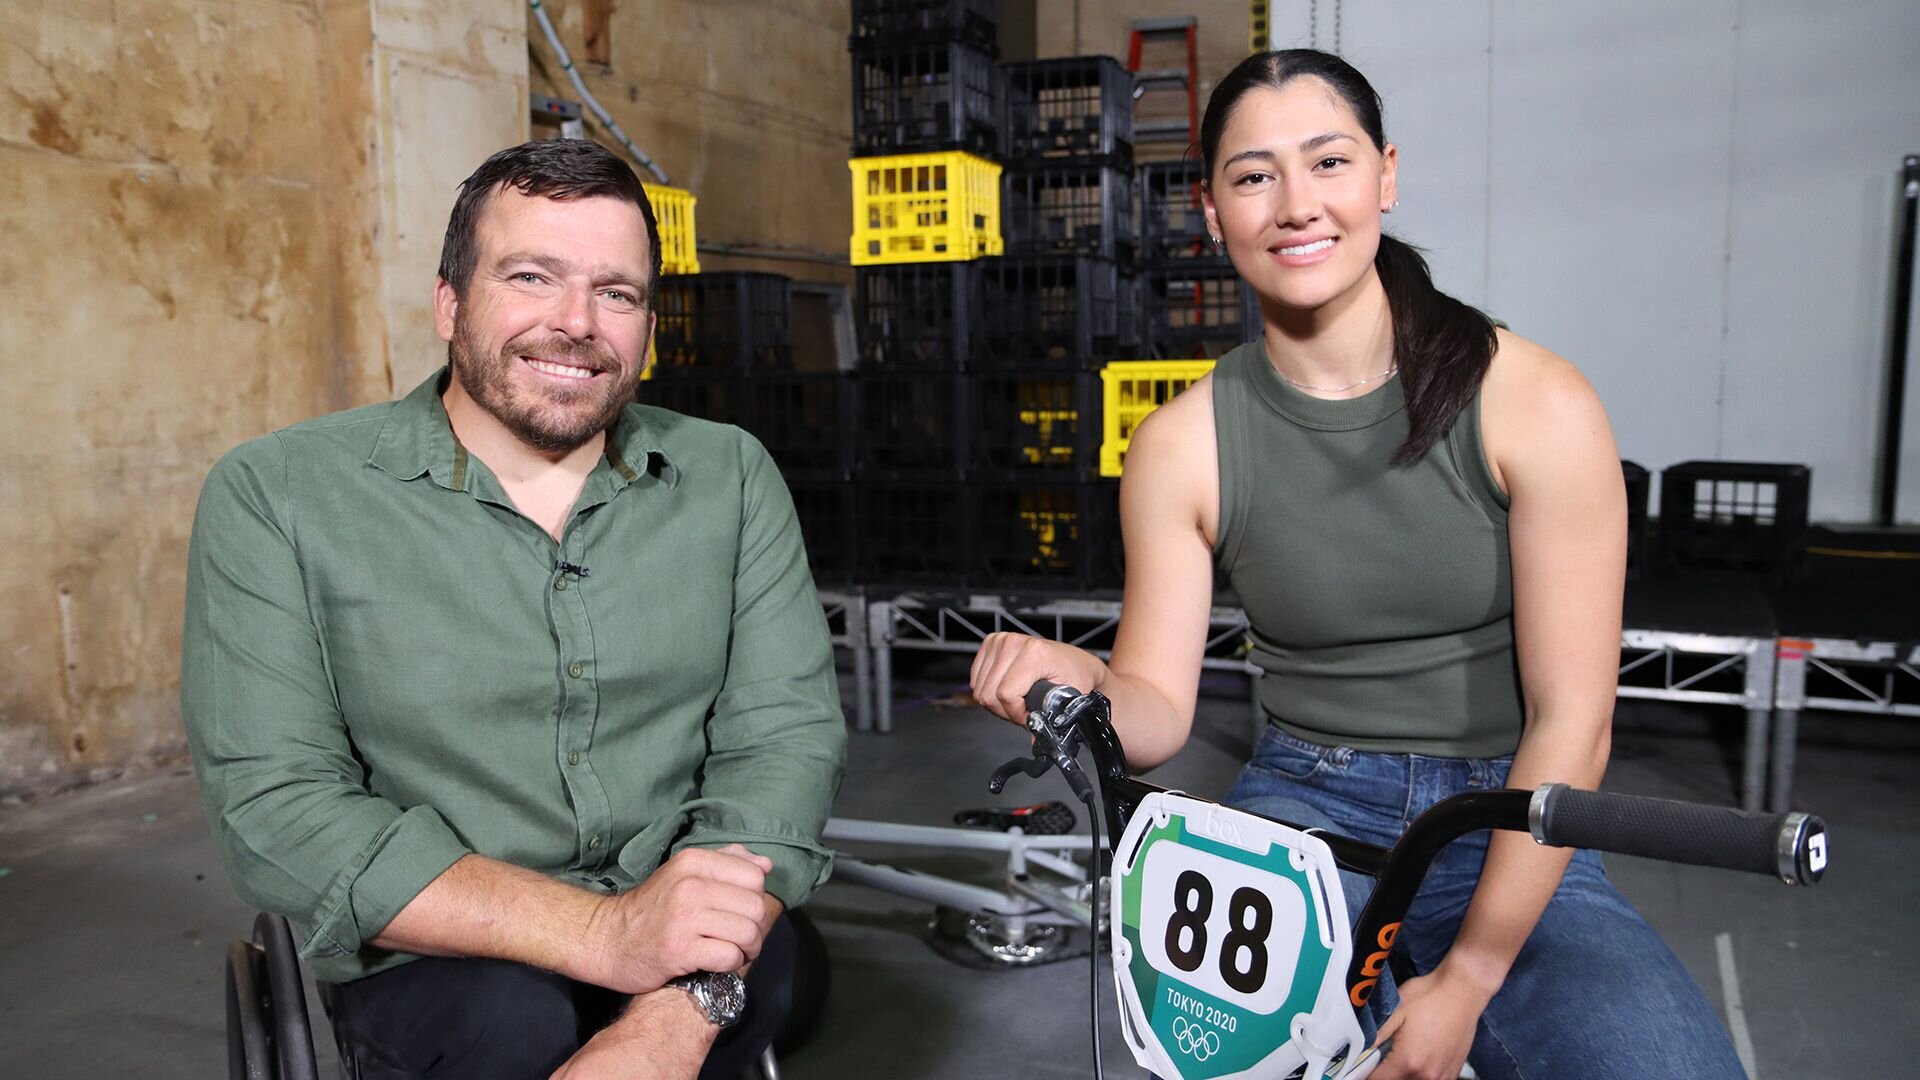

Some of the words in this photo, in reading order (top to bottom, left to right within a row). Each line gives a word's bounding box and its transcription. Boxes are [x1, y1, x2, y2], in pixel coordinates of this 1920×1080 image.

[1165, 870, 1272, 994] 88
[1167, 987, 1204, 1018] TOKYO
[1205, 1006, 1237, 1033] 2020
